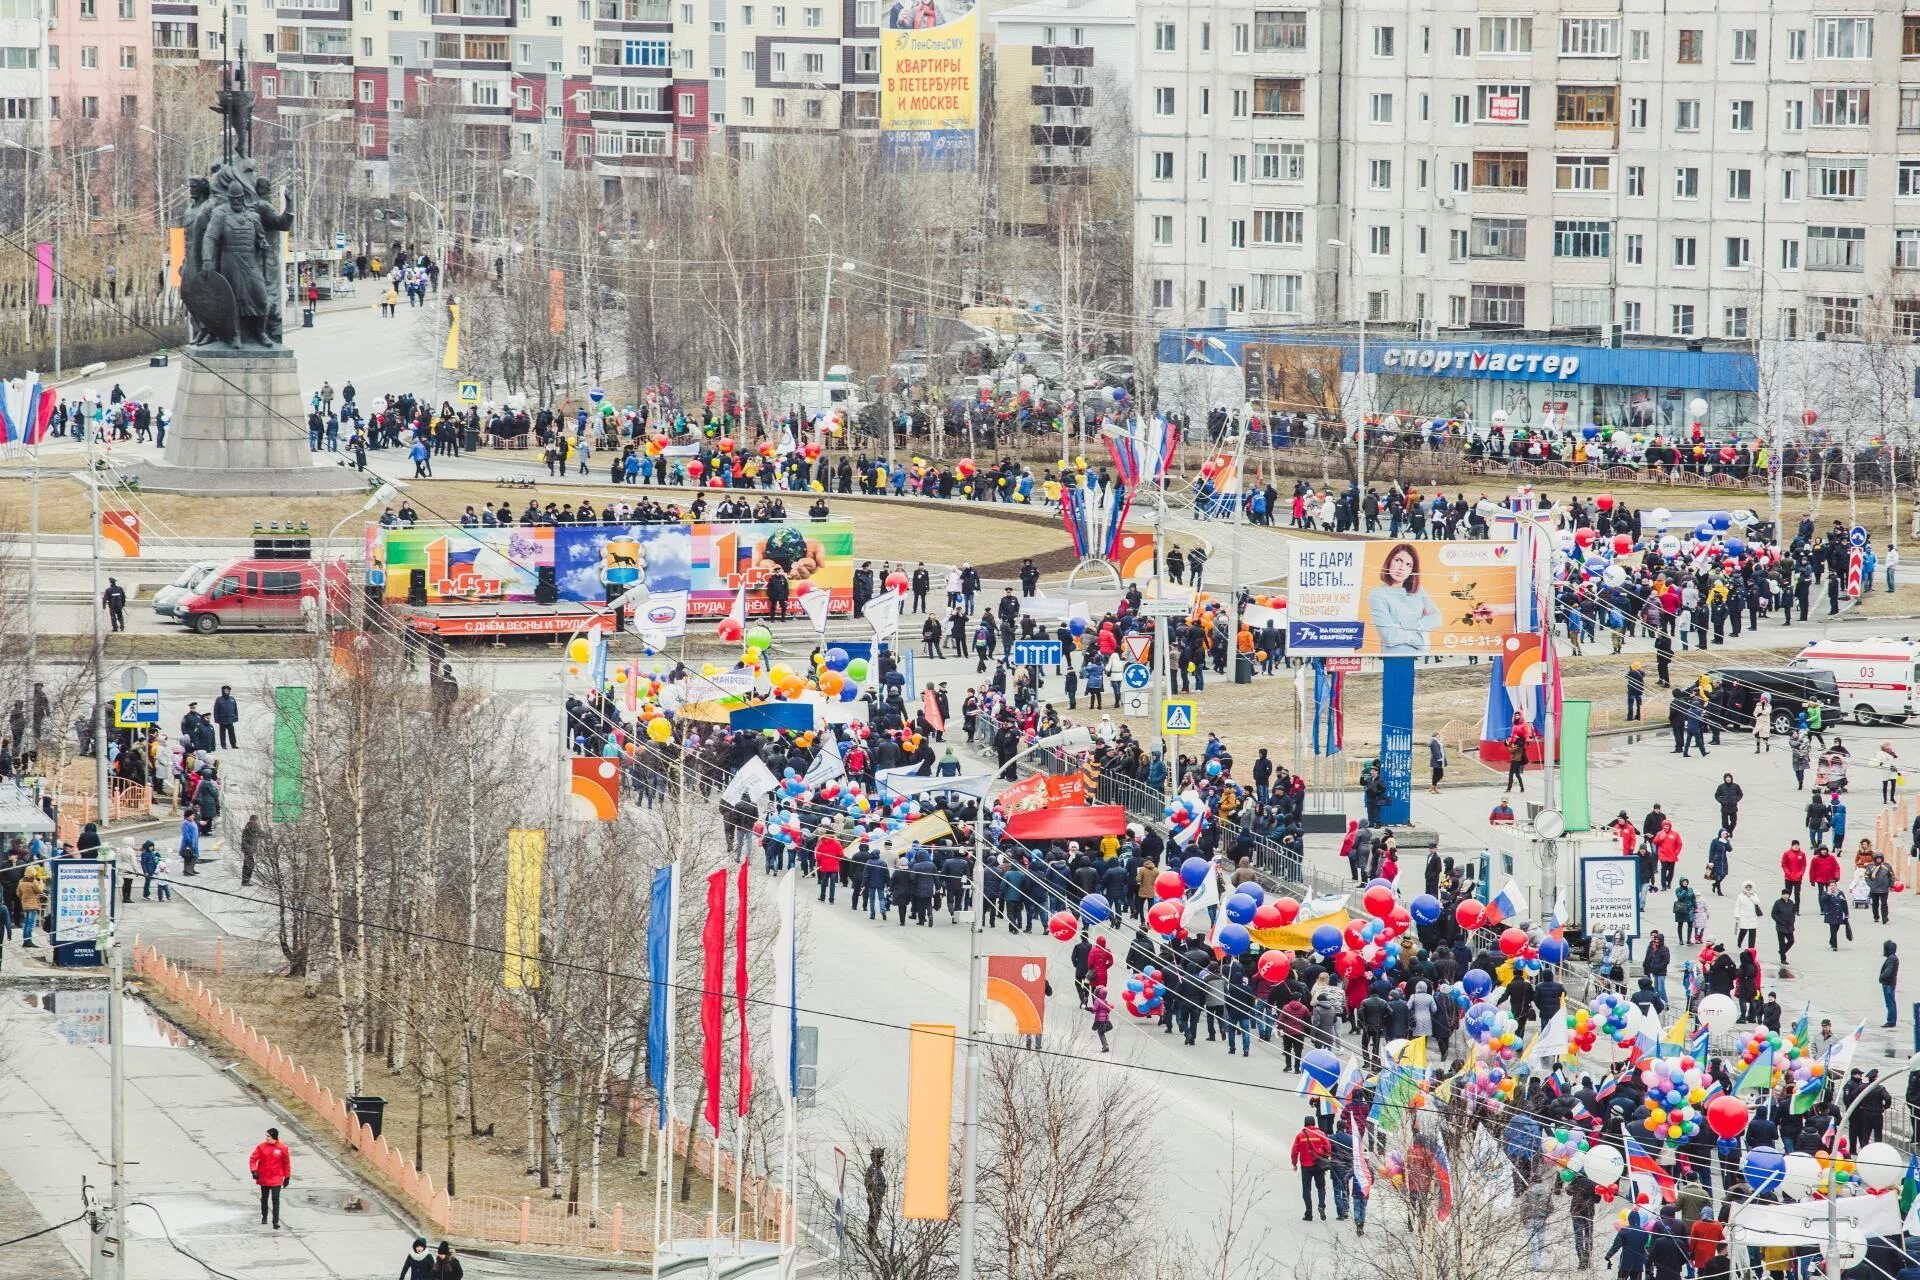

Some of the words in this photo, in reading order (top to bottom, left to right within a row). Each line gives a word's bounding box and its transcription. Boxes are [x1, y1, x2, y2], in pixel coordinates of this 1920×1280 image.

[896, 58, 961, 73] КВАРТИРЫ
[888, 78, 895, 92] В
[900, 76, 970, 92] ПЕТЕРБУРГЕ
[898, 97, 906, 110] И
[910, 96, 959, 110] МОСКВЕ
[1300, 552, 1316, 567] НЕ
[1319, 552, 1353, 568] ДАРИ
[437, 573, 501, 597] МАЯ
[1300, 572, 1354, 588] ЦВЕТЫ...
[1299, 594, 1333, 604] ПОДАРИ
[1335, 593, 1351, 604] УЖЕ
[692, 601, 726, 612] ТРУДА!
[1299, 605, 1340, 617] КВАРТИРУ
[465, 622, 473, 631] С
[475, 620, 505, 633] ДНЁМ
[506, 620, 543, 631] ВЕСНЫ
[545, 620, 553, 629] И
[1860, 667, 1875, 678] 03
